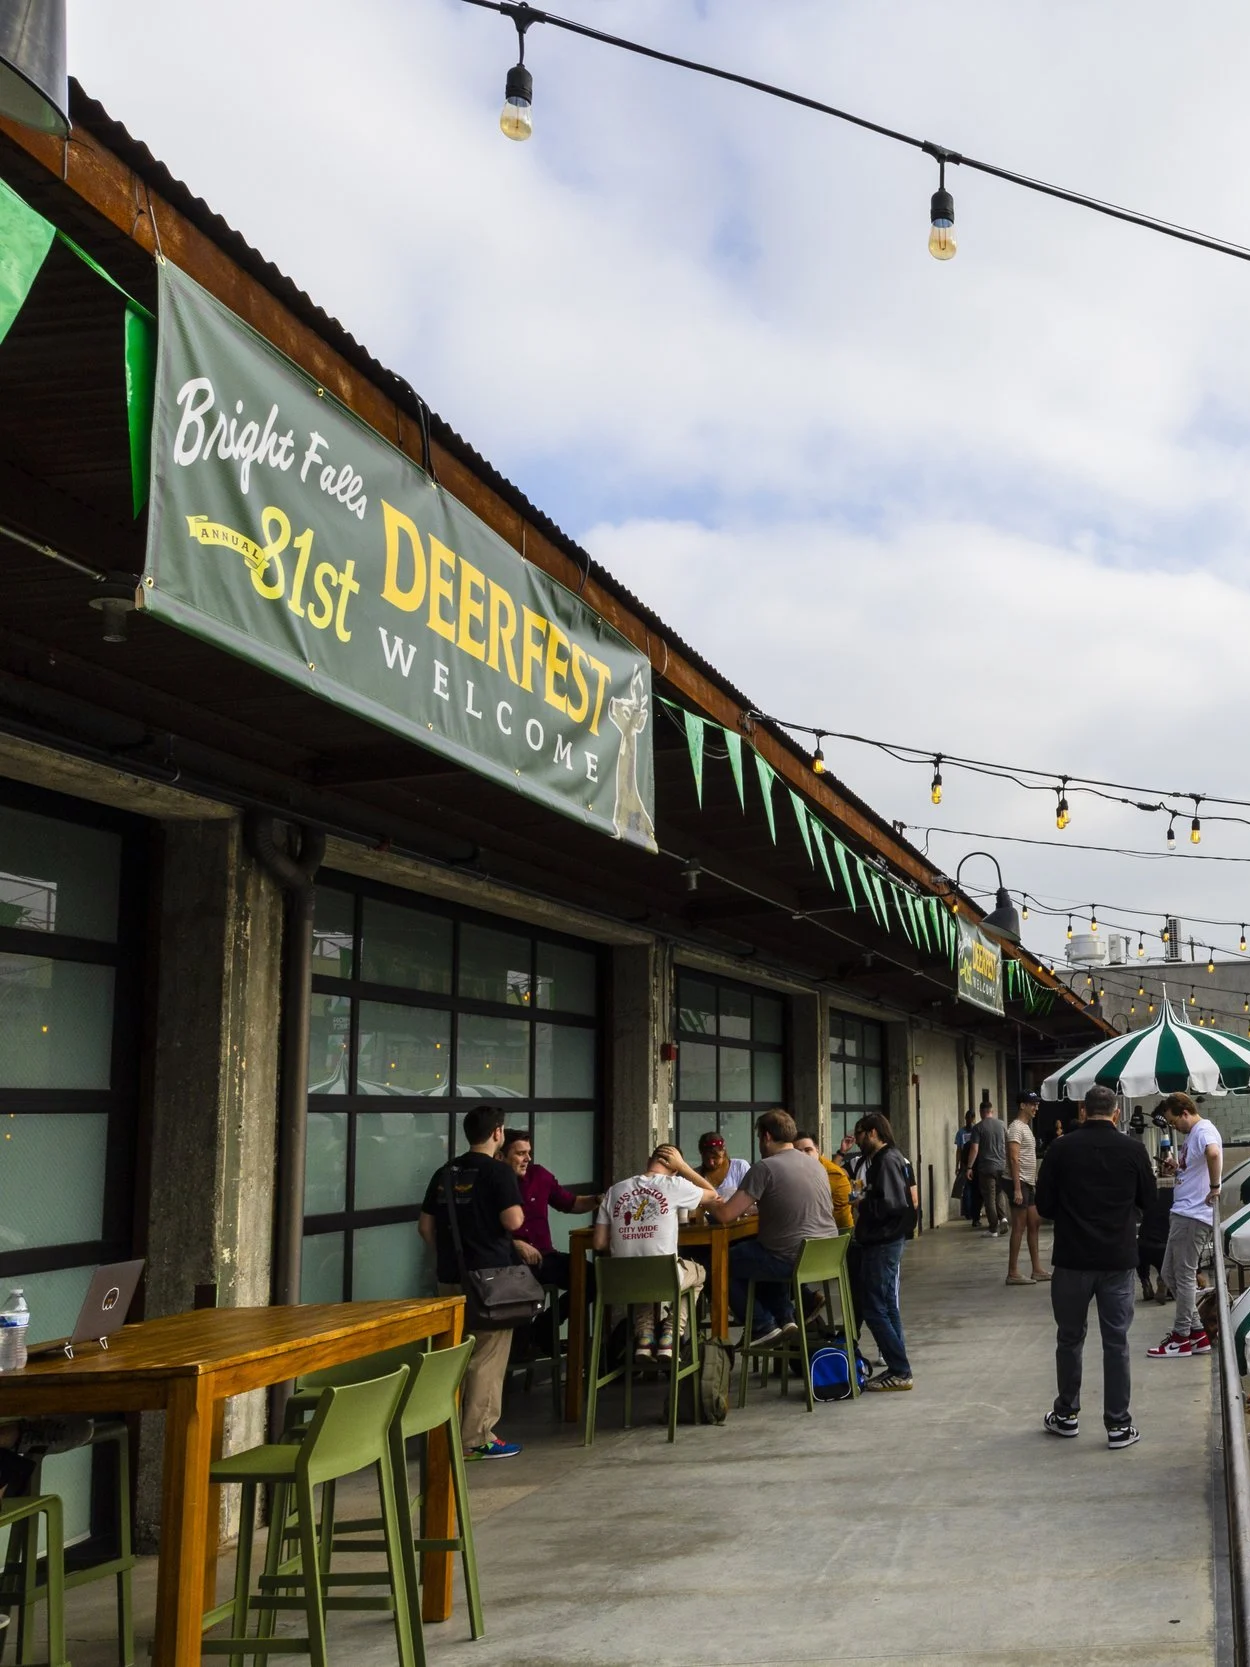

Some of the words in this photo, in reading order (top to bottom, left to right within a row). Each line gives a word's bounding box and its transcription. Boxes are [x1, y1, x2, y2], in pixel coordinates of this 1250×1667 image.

[173, 377, 295, 494] Bright
[300, 431, 368, 520] Falls
[200, 528, 260, 560] ANNUAL
[250, 505, 360, 643] 81st
[380, 499, 611, 736] DEERFEST
[378, 627, 599, 783] WELCOME
[613, 1192, 631, 1218] DEUS
[631, 1187, 669, 1215] CUSTOMS
[618, 1226, 636, 1234] CITY
[637, 1224, 659, 1232] WIDE
[622, 1232, 655, 1241] SERVICE
